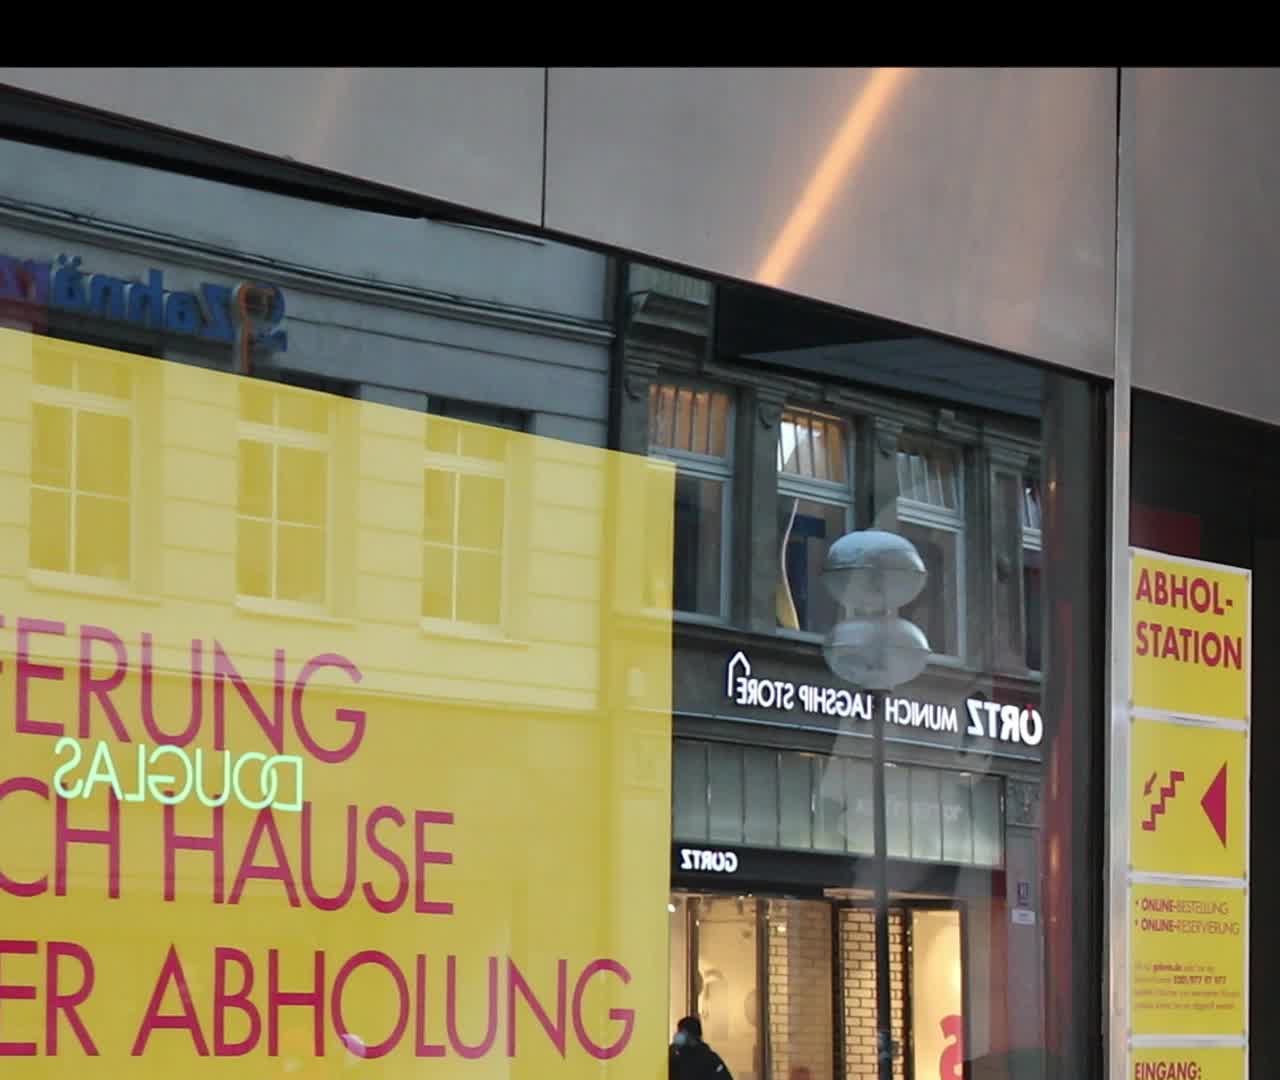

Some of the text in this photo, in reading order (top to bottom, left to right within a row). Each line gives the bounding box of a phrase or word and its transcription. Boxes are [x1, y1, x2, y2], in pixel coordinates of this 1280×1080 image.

[1135, 567, 1233, 616] ABHOL-
[1135, 620, 1242, 670] STATION
[0, 615, 366, 763] ERUNG
[163, 789, 455, 915] HAUSE
[131, 942, 636, 1061] ABHOLUNG
[1134, 1061, 1202, 1080] EINGANG:
